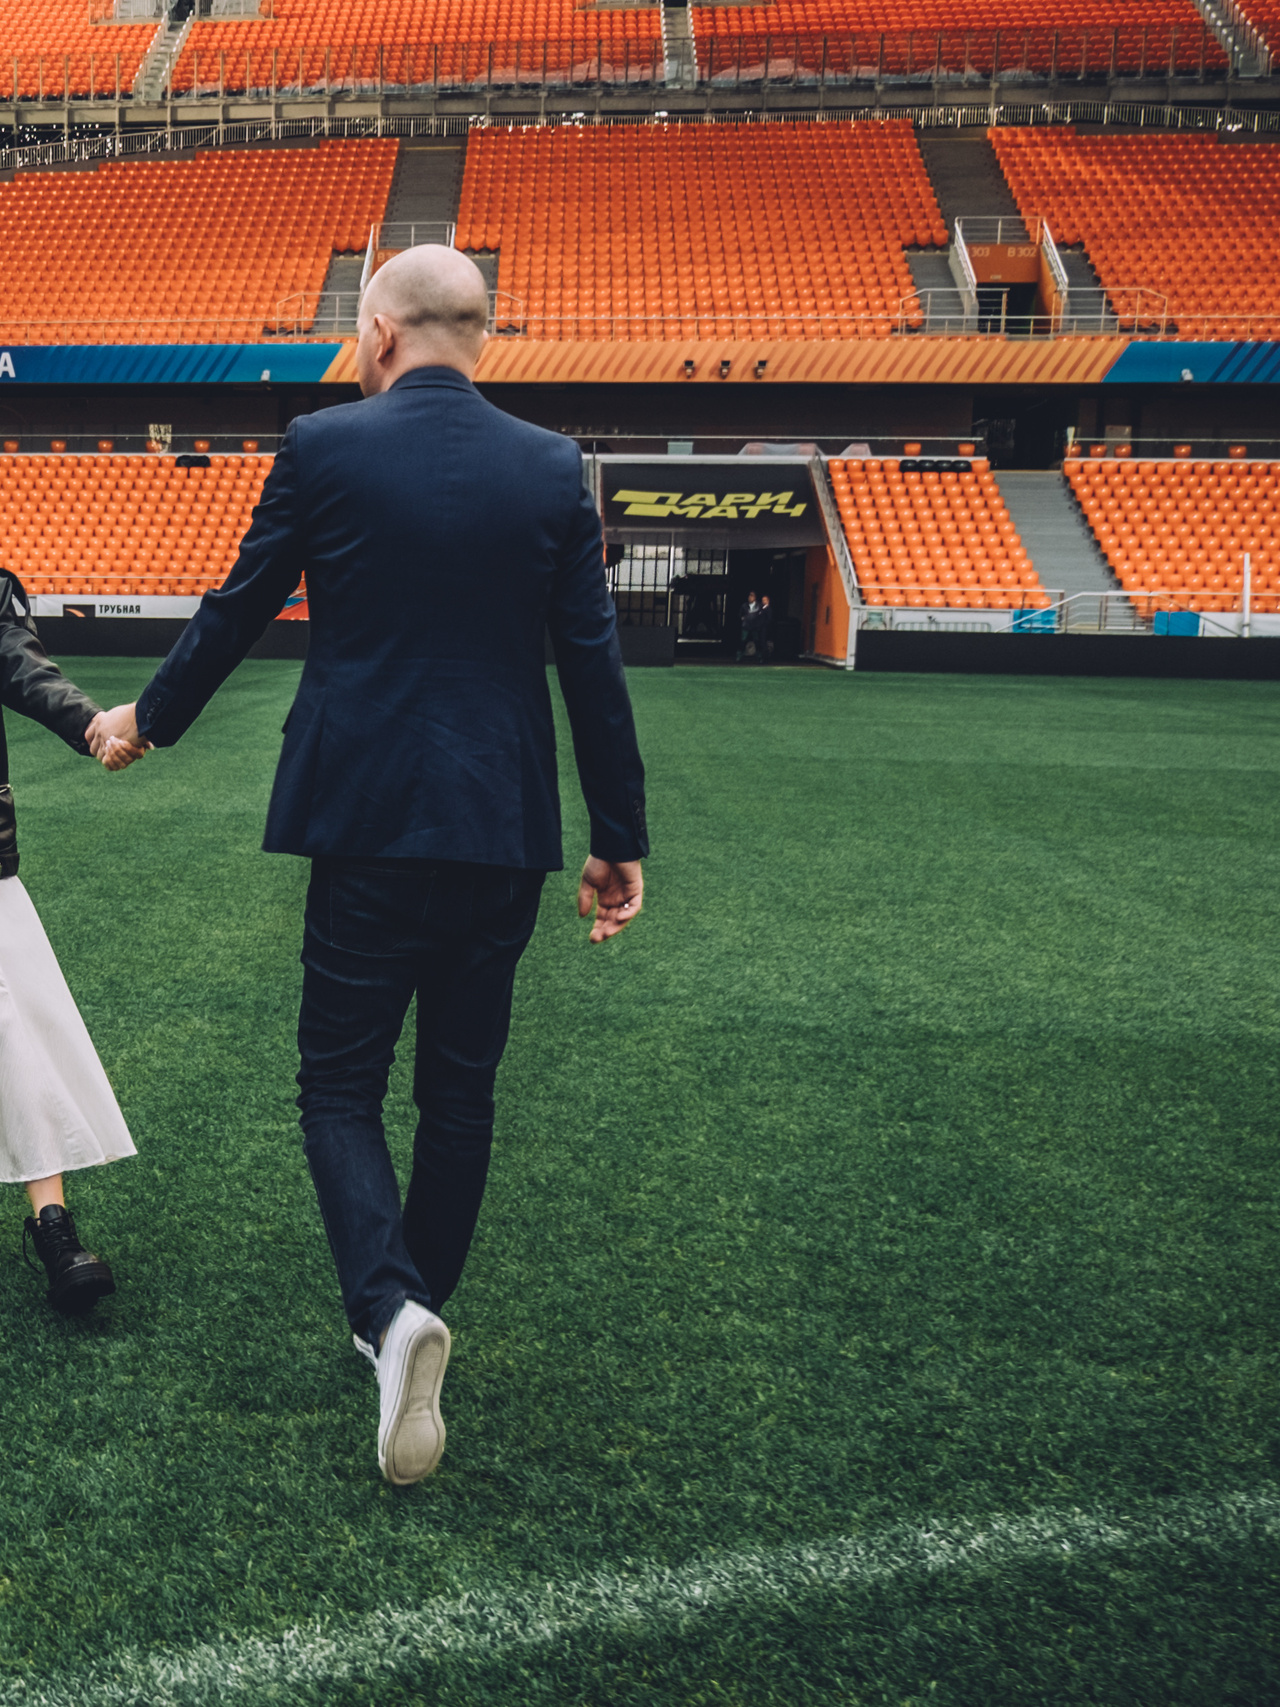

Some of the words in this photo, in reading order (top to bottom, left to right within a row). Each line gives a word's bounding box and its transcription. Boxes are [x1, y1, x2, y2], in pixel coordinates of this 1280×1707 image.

[611, 489, 794, 507] ПАРИ
[623, 503, 808, 519] МАТЧ
[99, 604, 141, 614] ТРУБНАЯ
